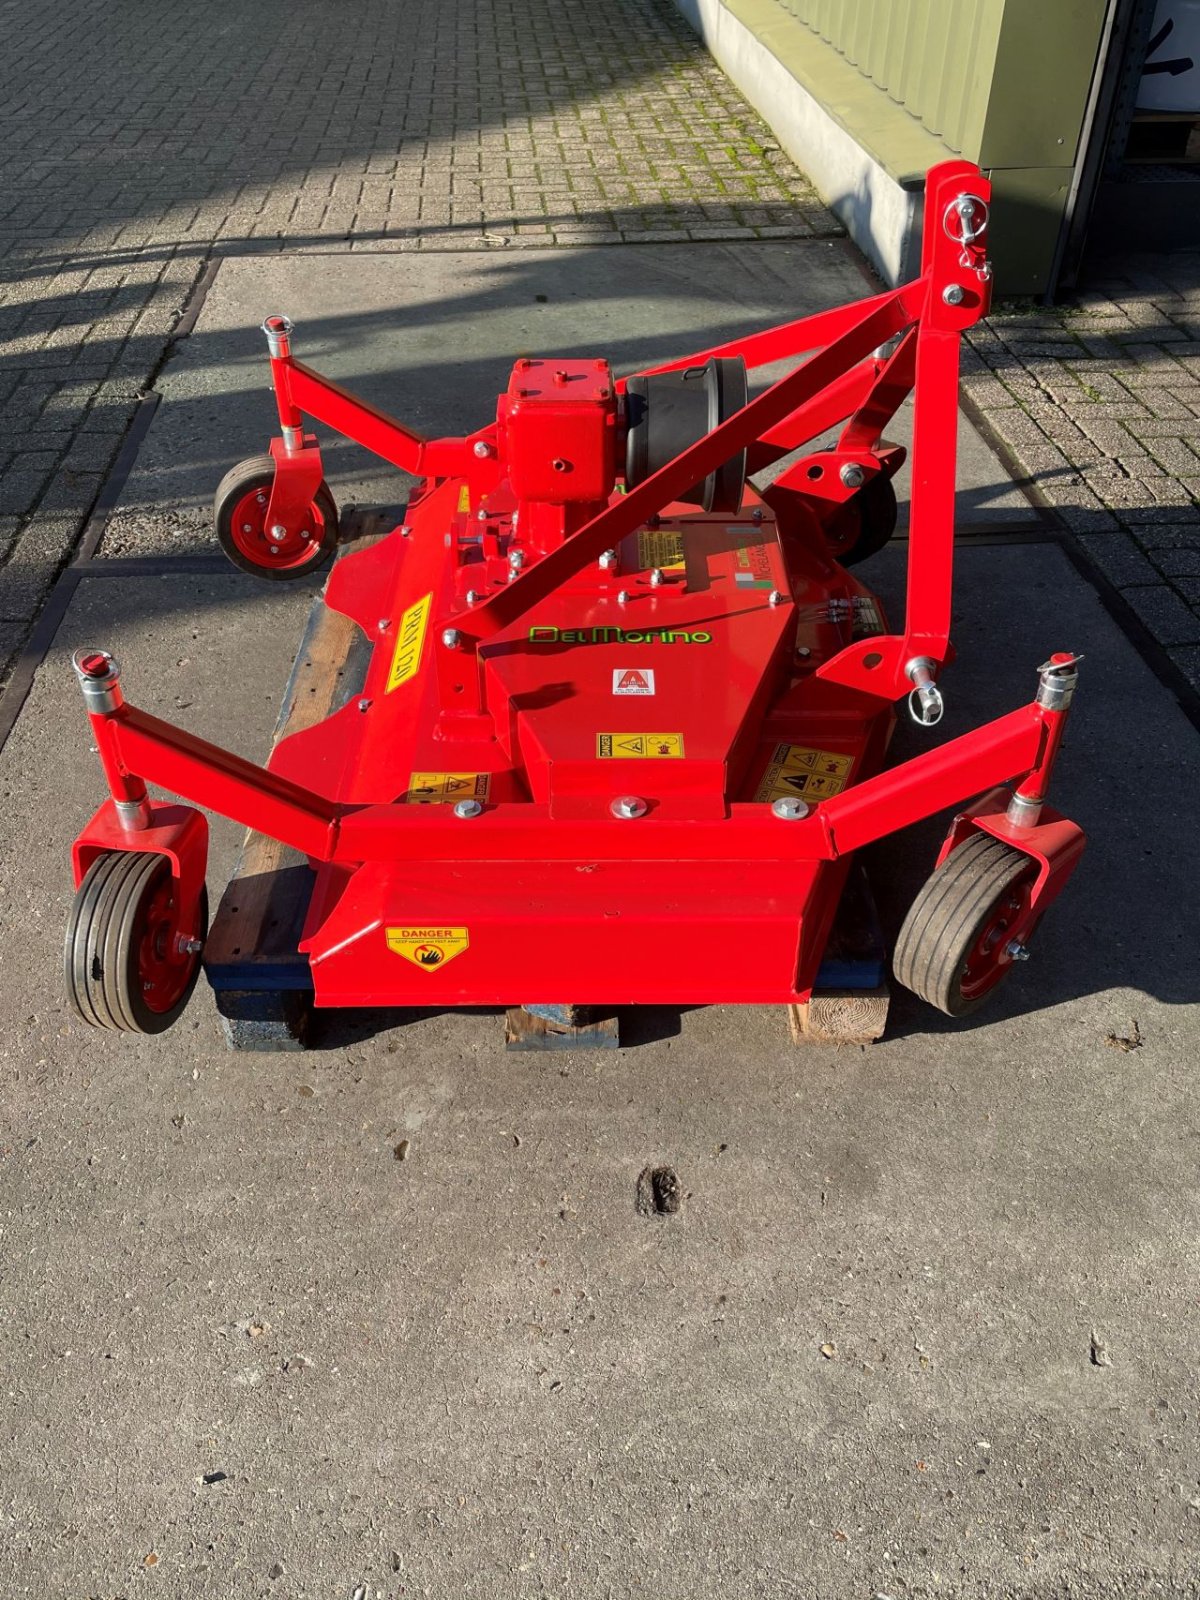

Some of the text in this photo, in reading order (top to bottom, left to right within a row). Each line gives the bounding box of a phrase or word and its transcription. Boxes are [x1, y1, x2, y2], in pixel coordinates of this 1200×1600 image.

[394, 605, 424, 681] PRM 120
[401, 930, 453, 938] DANGER
